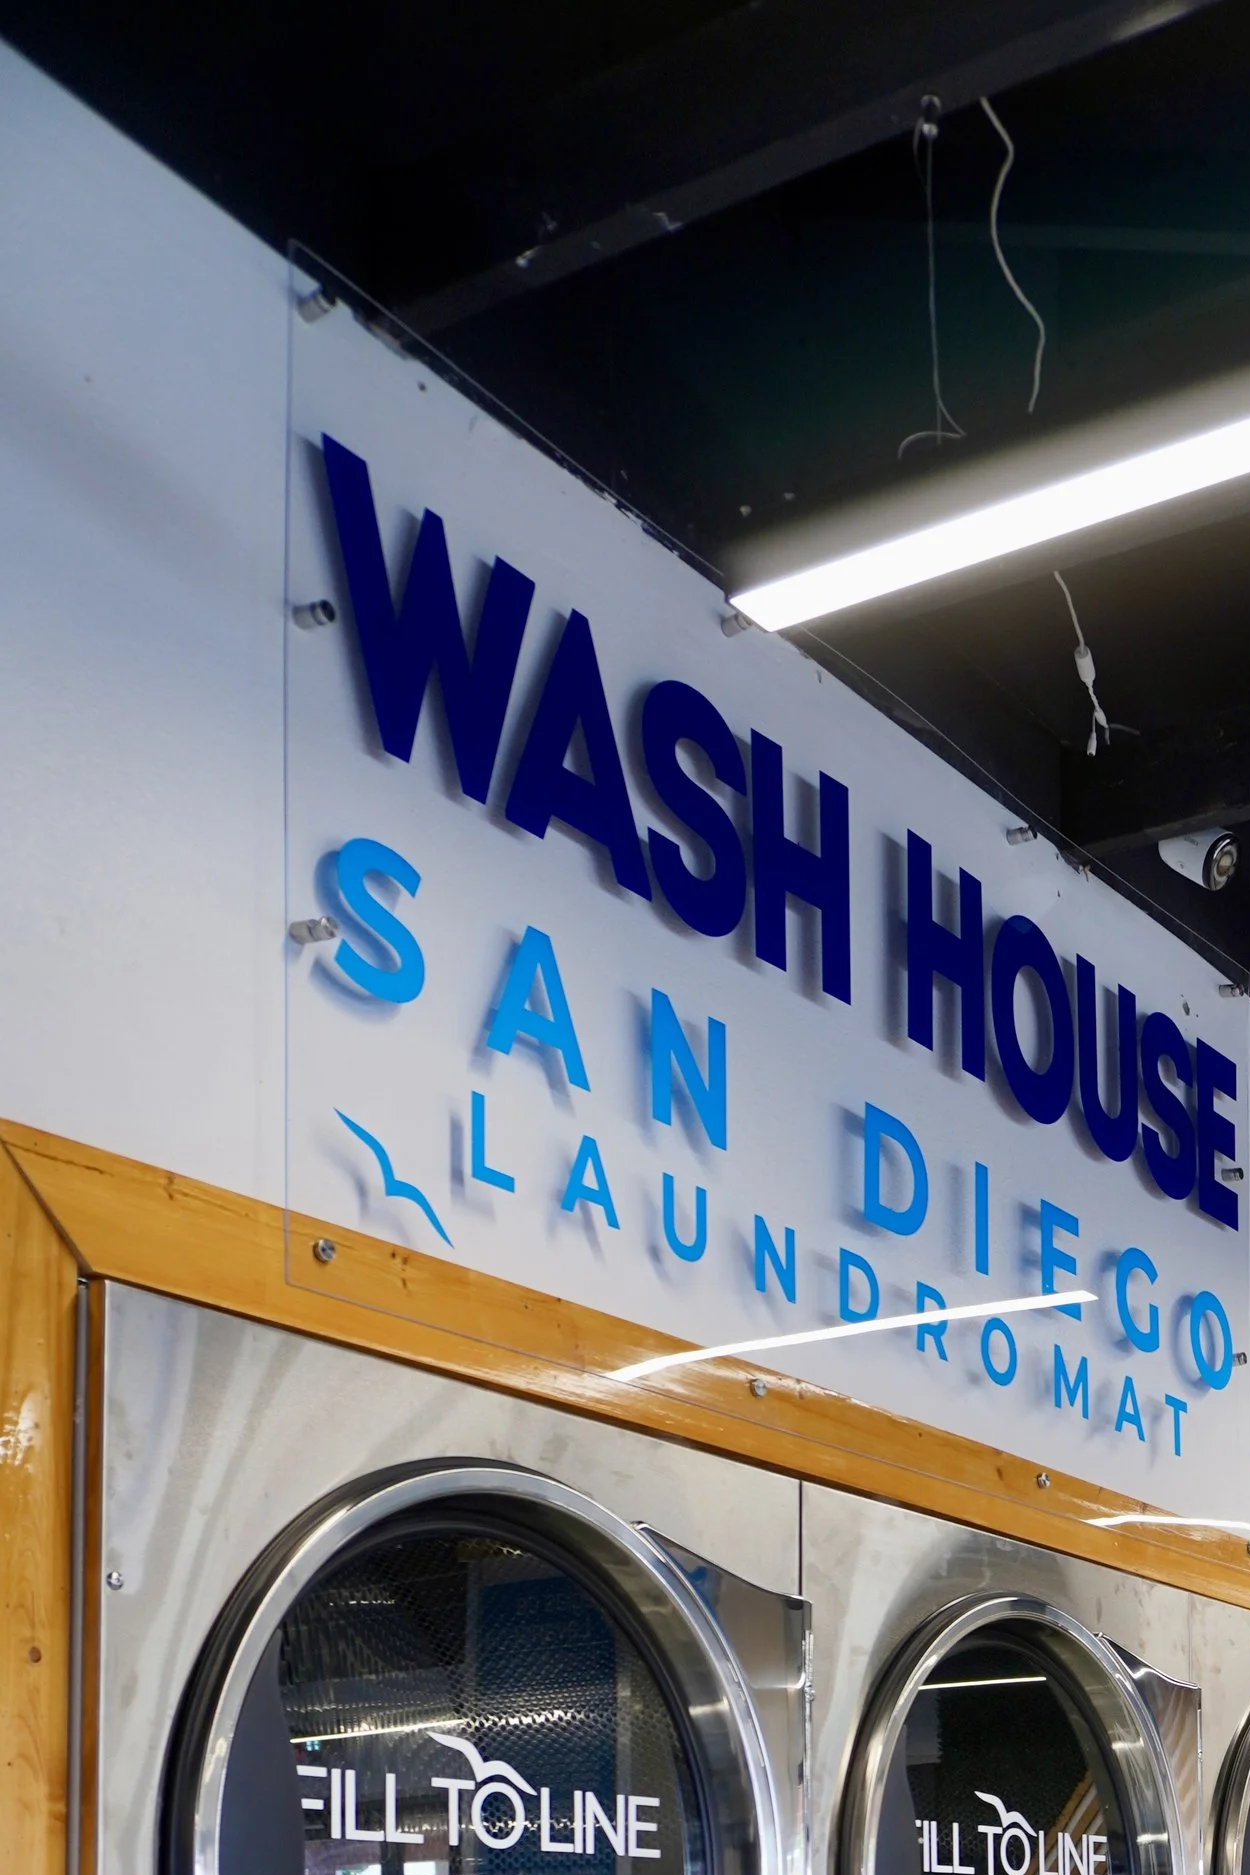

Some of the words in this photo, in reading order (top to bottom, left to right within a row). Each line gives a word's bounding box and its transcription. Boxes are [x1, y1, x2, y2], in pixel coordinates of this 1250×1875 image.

[322, 433, 851, 1006] WASH
[904, 828, 1239, 1231] HOUSE
[332, 837, 727, 1151] SAN
[863, 1103, 1234, 1391] DIEGO
[471, 1090, 1189, 1457] LAUNDROMAT
[431, 1777, 525, 1849] TO
[540, 1787, 662, 1858] LINE
